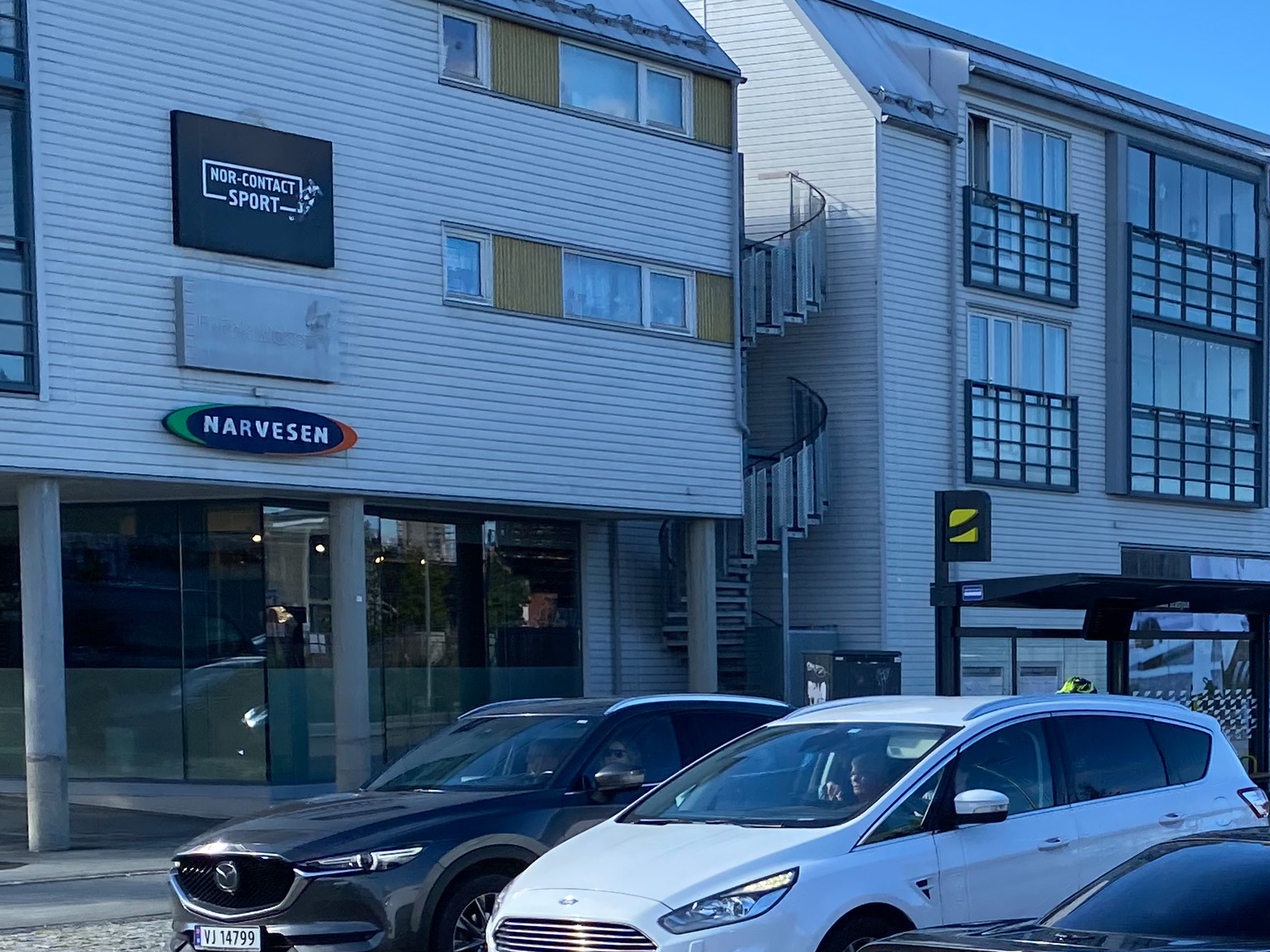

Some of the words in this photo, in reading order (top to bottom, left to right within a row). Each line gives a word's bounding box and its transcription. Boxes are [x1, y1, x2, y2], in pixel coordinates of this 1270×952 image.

[210, 166, 295, 195] NOR-CONTACT
[228, 189, 279, 213] SPORT
[203, 415, 329, 444] NARVESEN
[204, 929, 216, 945] VJ
[220, 930, 255, 946] 14799
